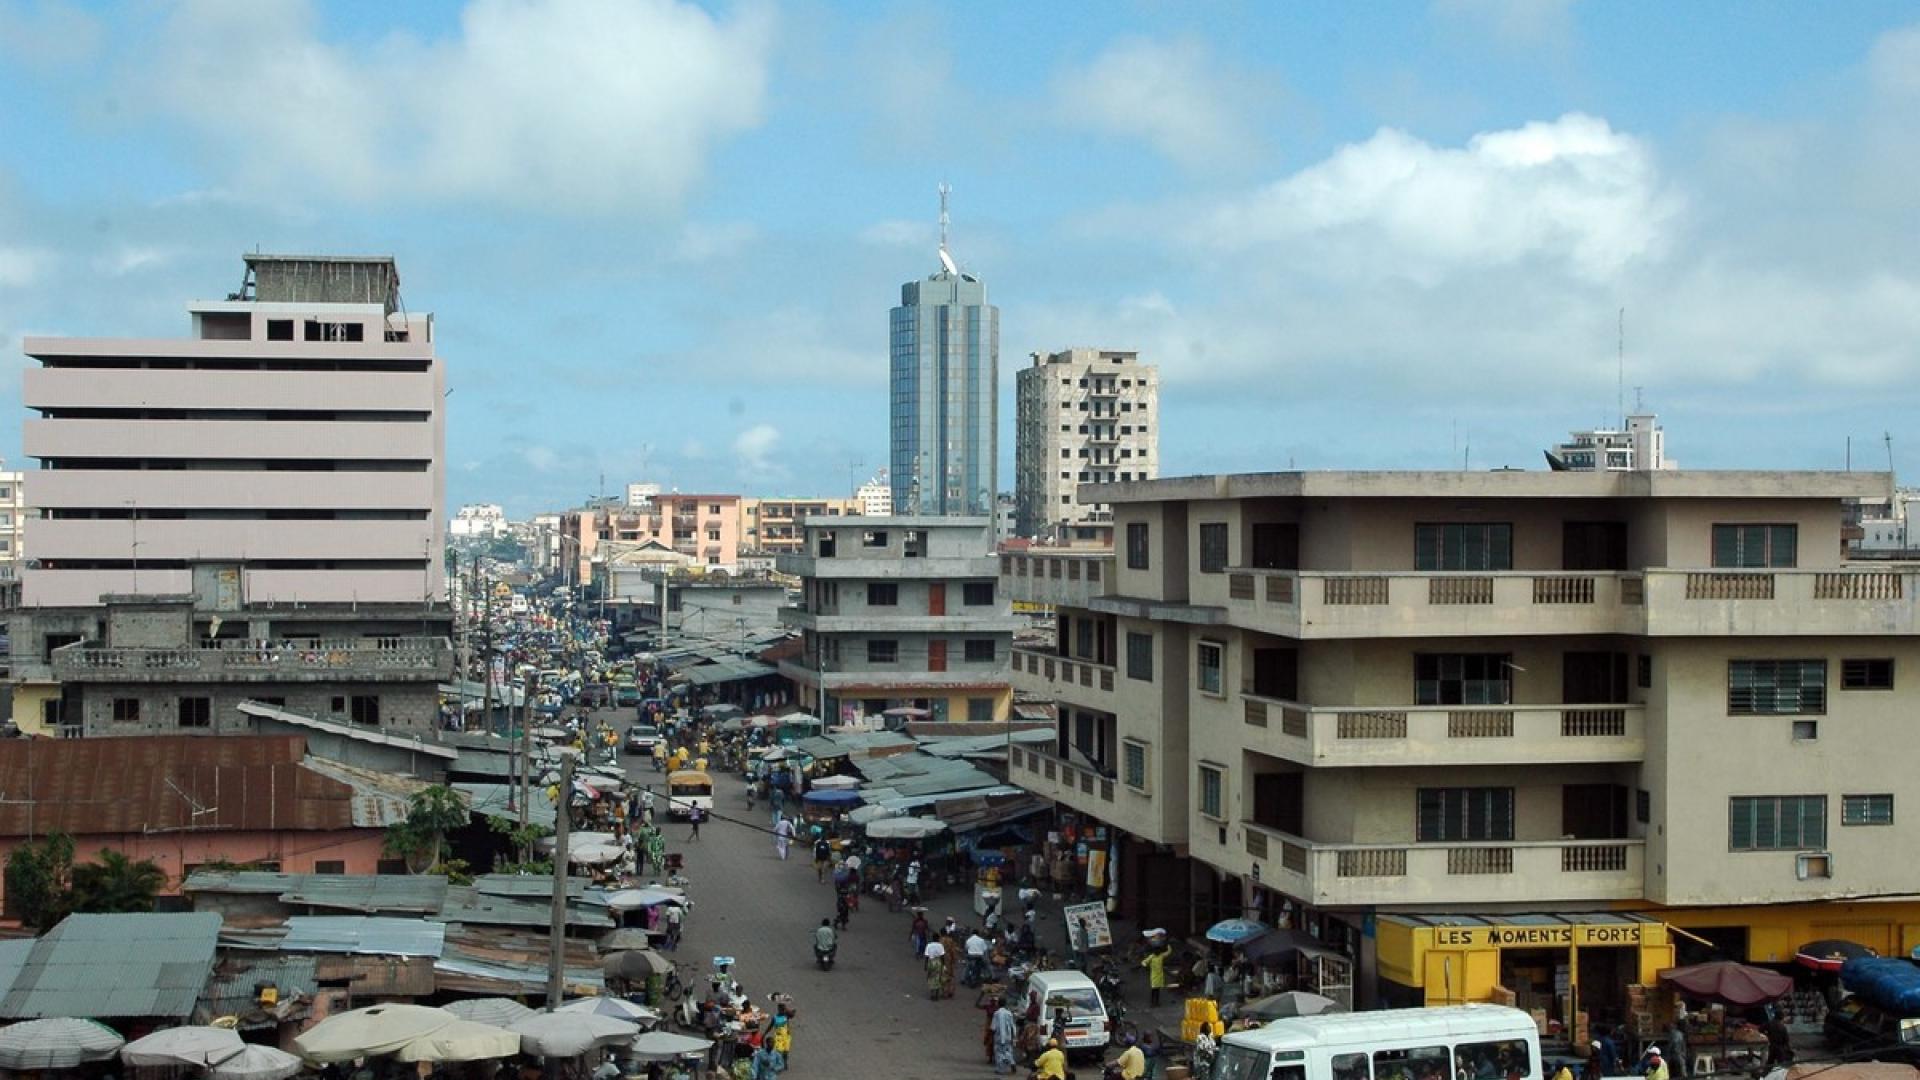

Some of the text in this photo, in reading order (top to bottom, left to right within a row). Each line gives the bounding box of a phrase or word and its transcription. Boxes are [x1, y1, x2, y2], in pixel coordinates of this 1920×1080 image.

[1439, 928, 1640, 944] LES MOMENTS FORTS
